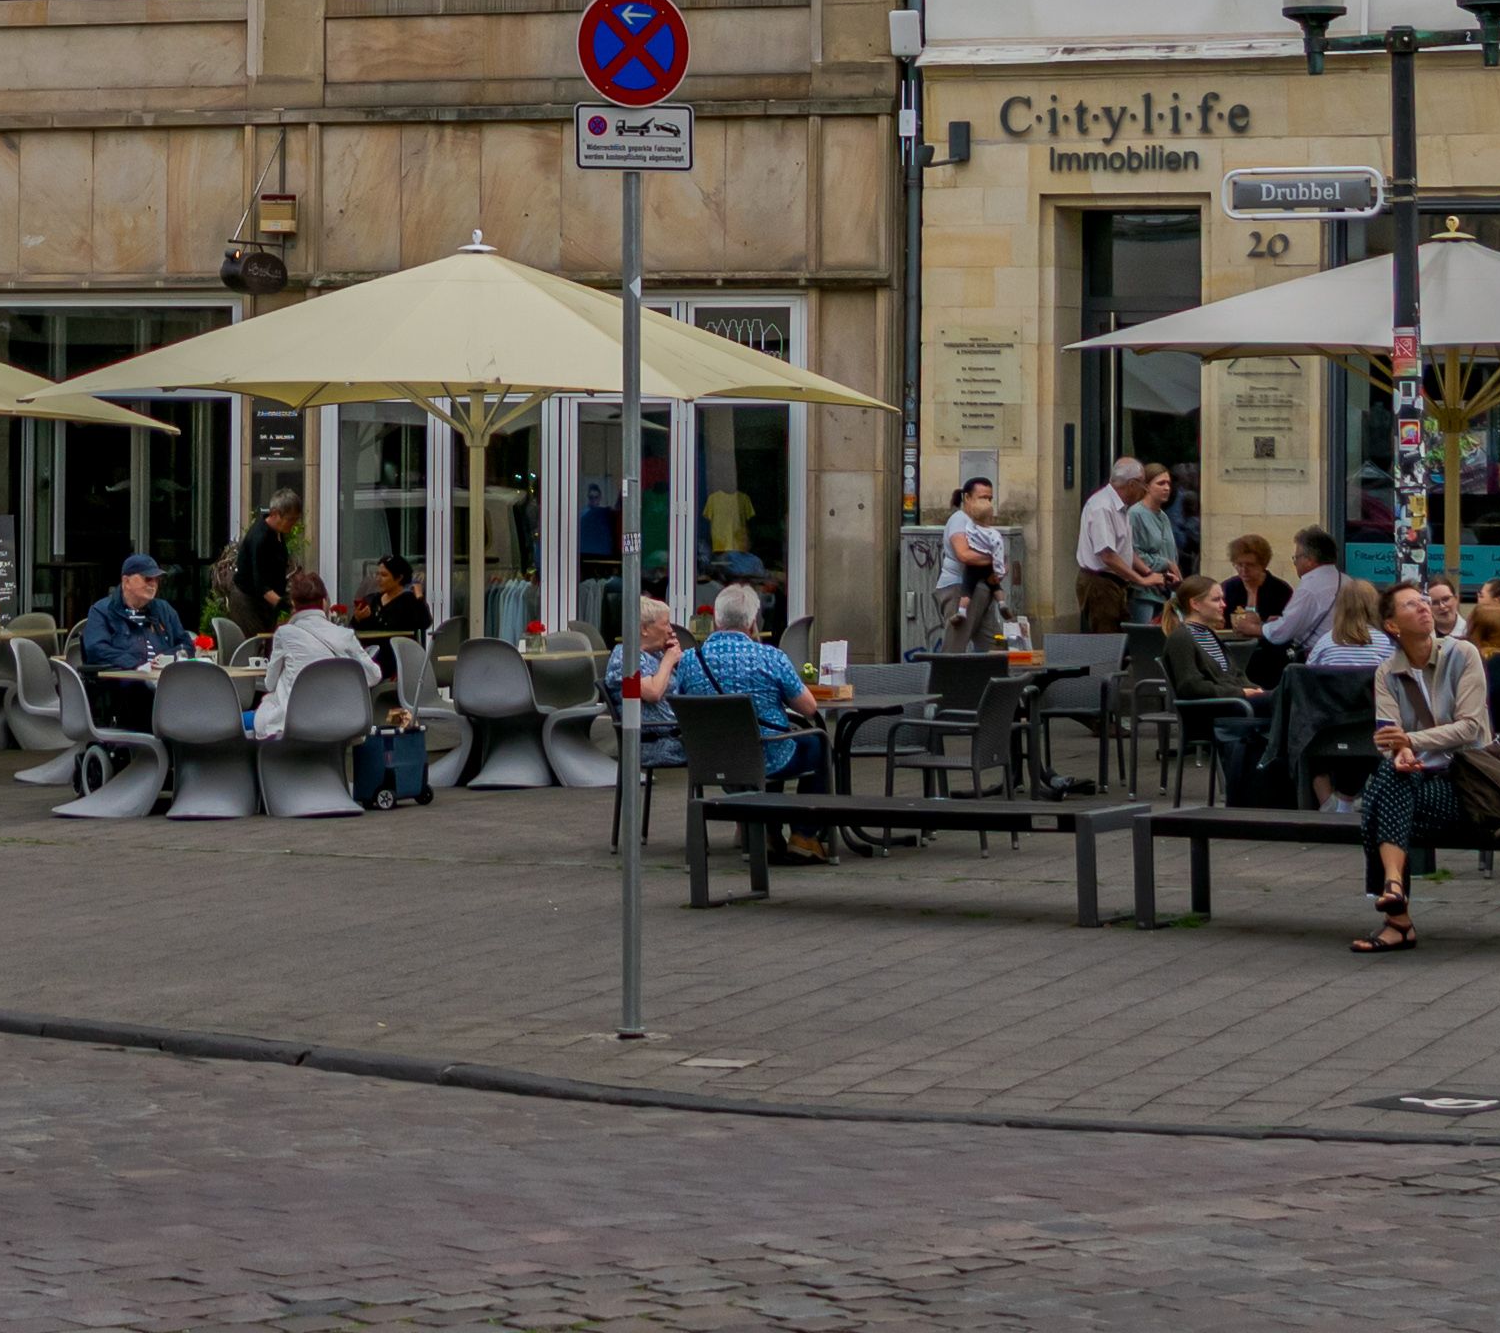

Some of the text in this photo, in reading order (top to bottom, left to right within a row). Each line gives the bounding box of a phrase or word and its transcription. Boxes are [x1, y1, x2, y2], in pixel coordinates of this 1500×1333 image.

[1050, 145, 1199, 172] Immobilien
[1260, 183, 1341, 201] Drubbel
[1246, 231, 1290, 258] 20
